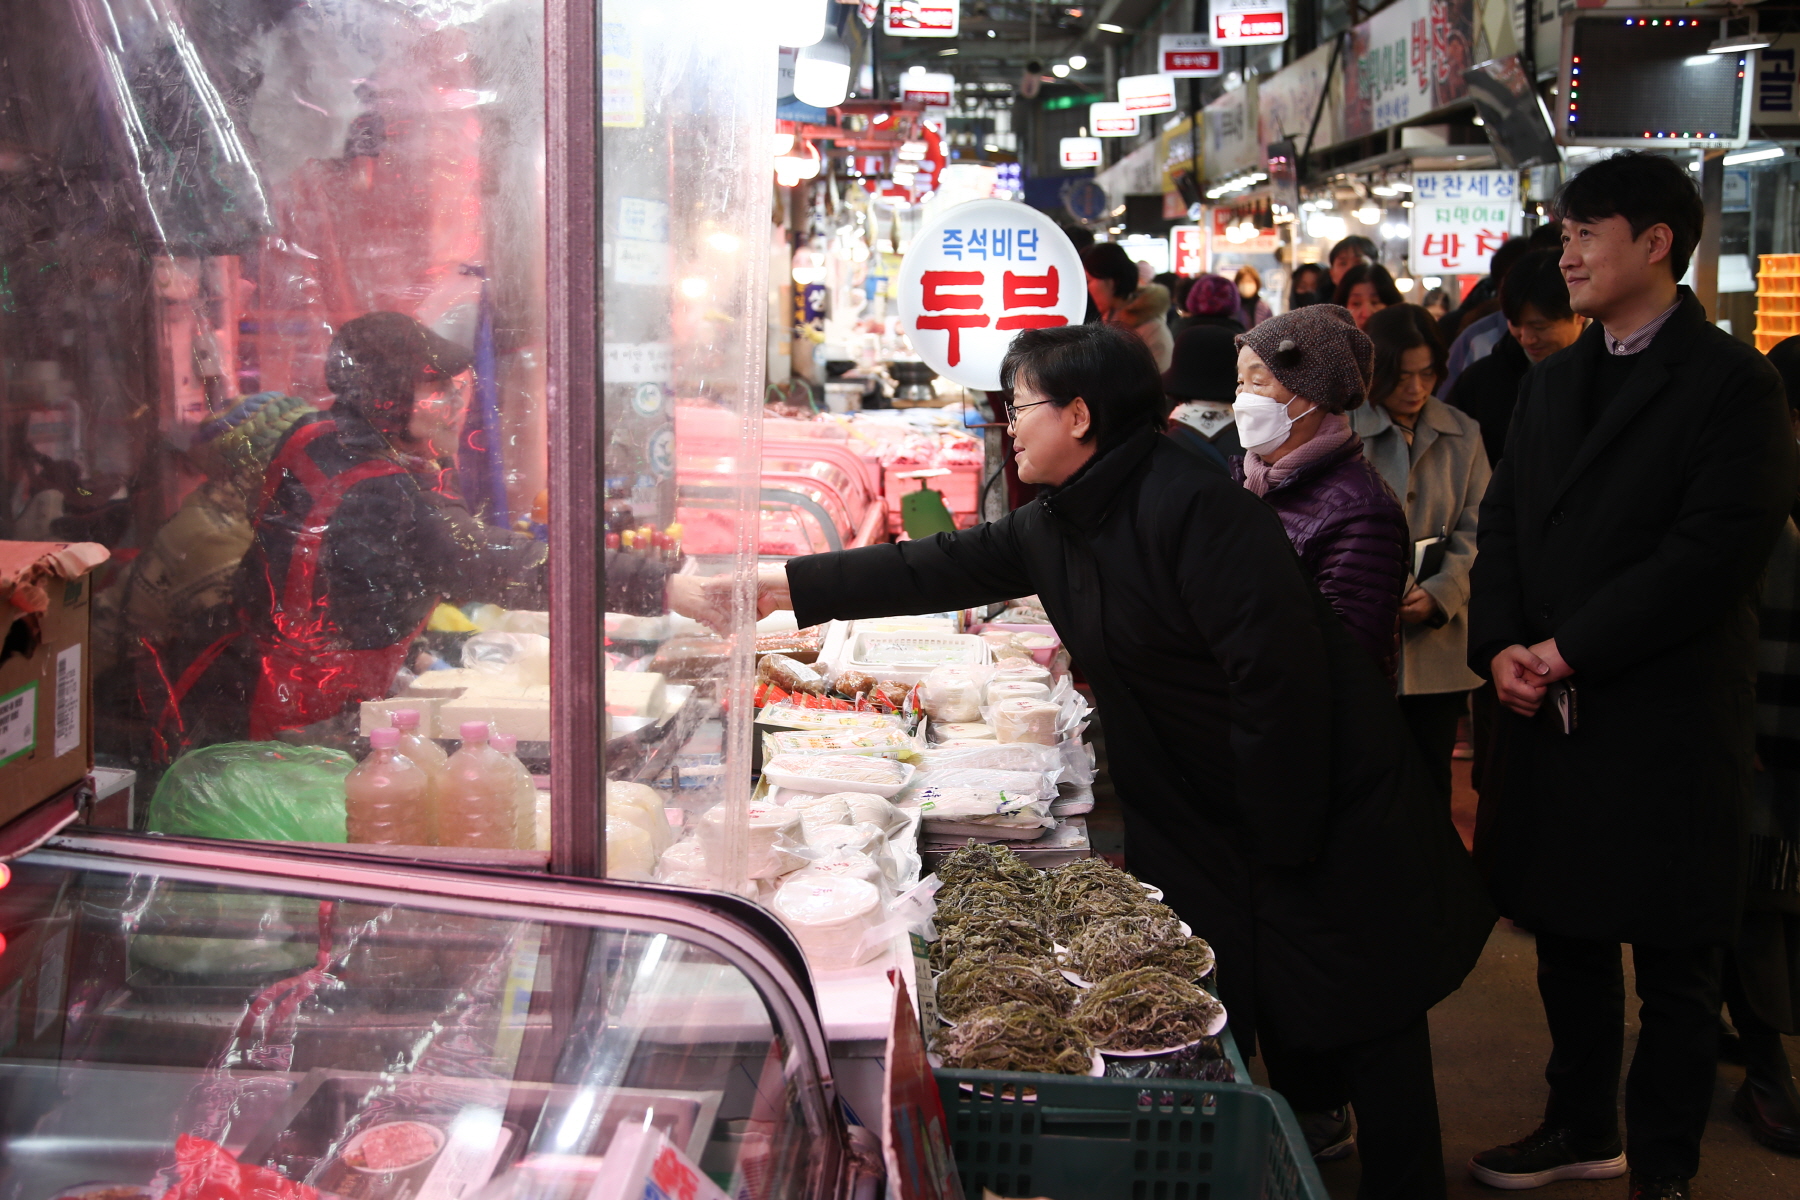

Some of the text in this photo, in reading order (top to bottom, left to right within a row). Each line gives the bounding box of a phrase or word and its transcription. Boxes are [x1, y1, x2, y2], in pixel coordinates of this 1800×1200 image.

[1417, 174, 1514, 198] 반찬세상
[942, 228, 1039, 261] 즉석비단
[916, 265, 1069, 367] 두부
